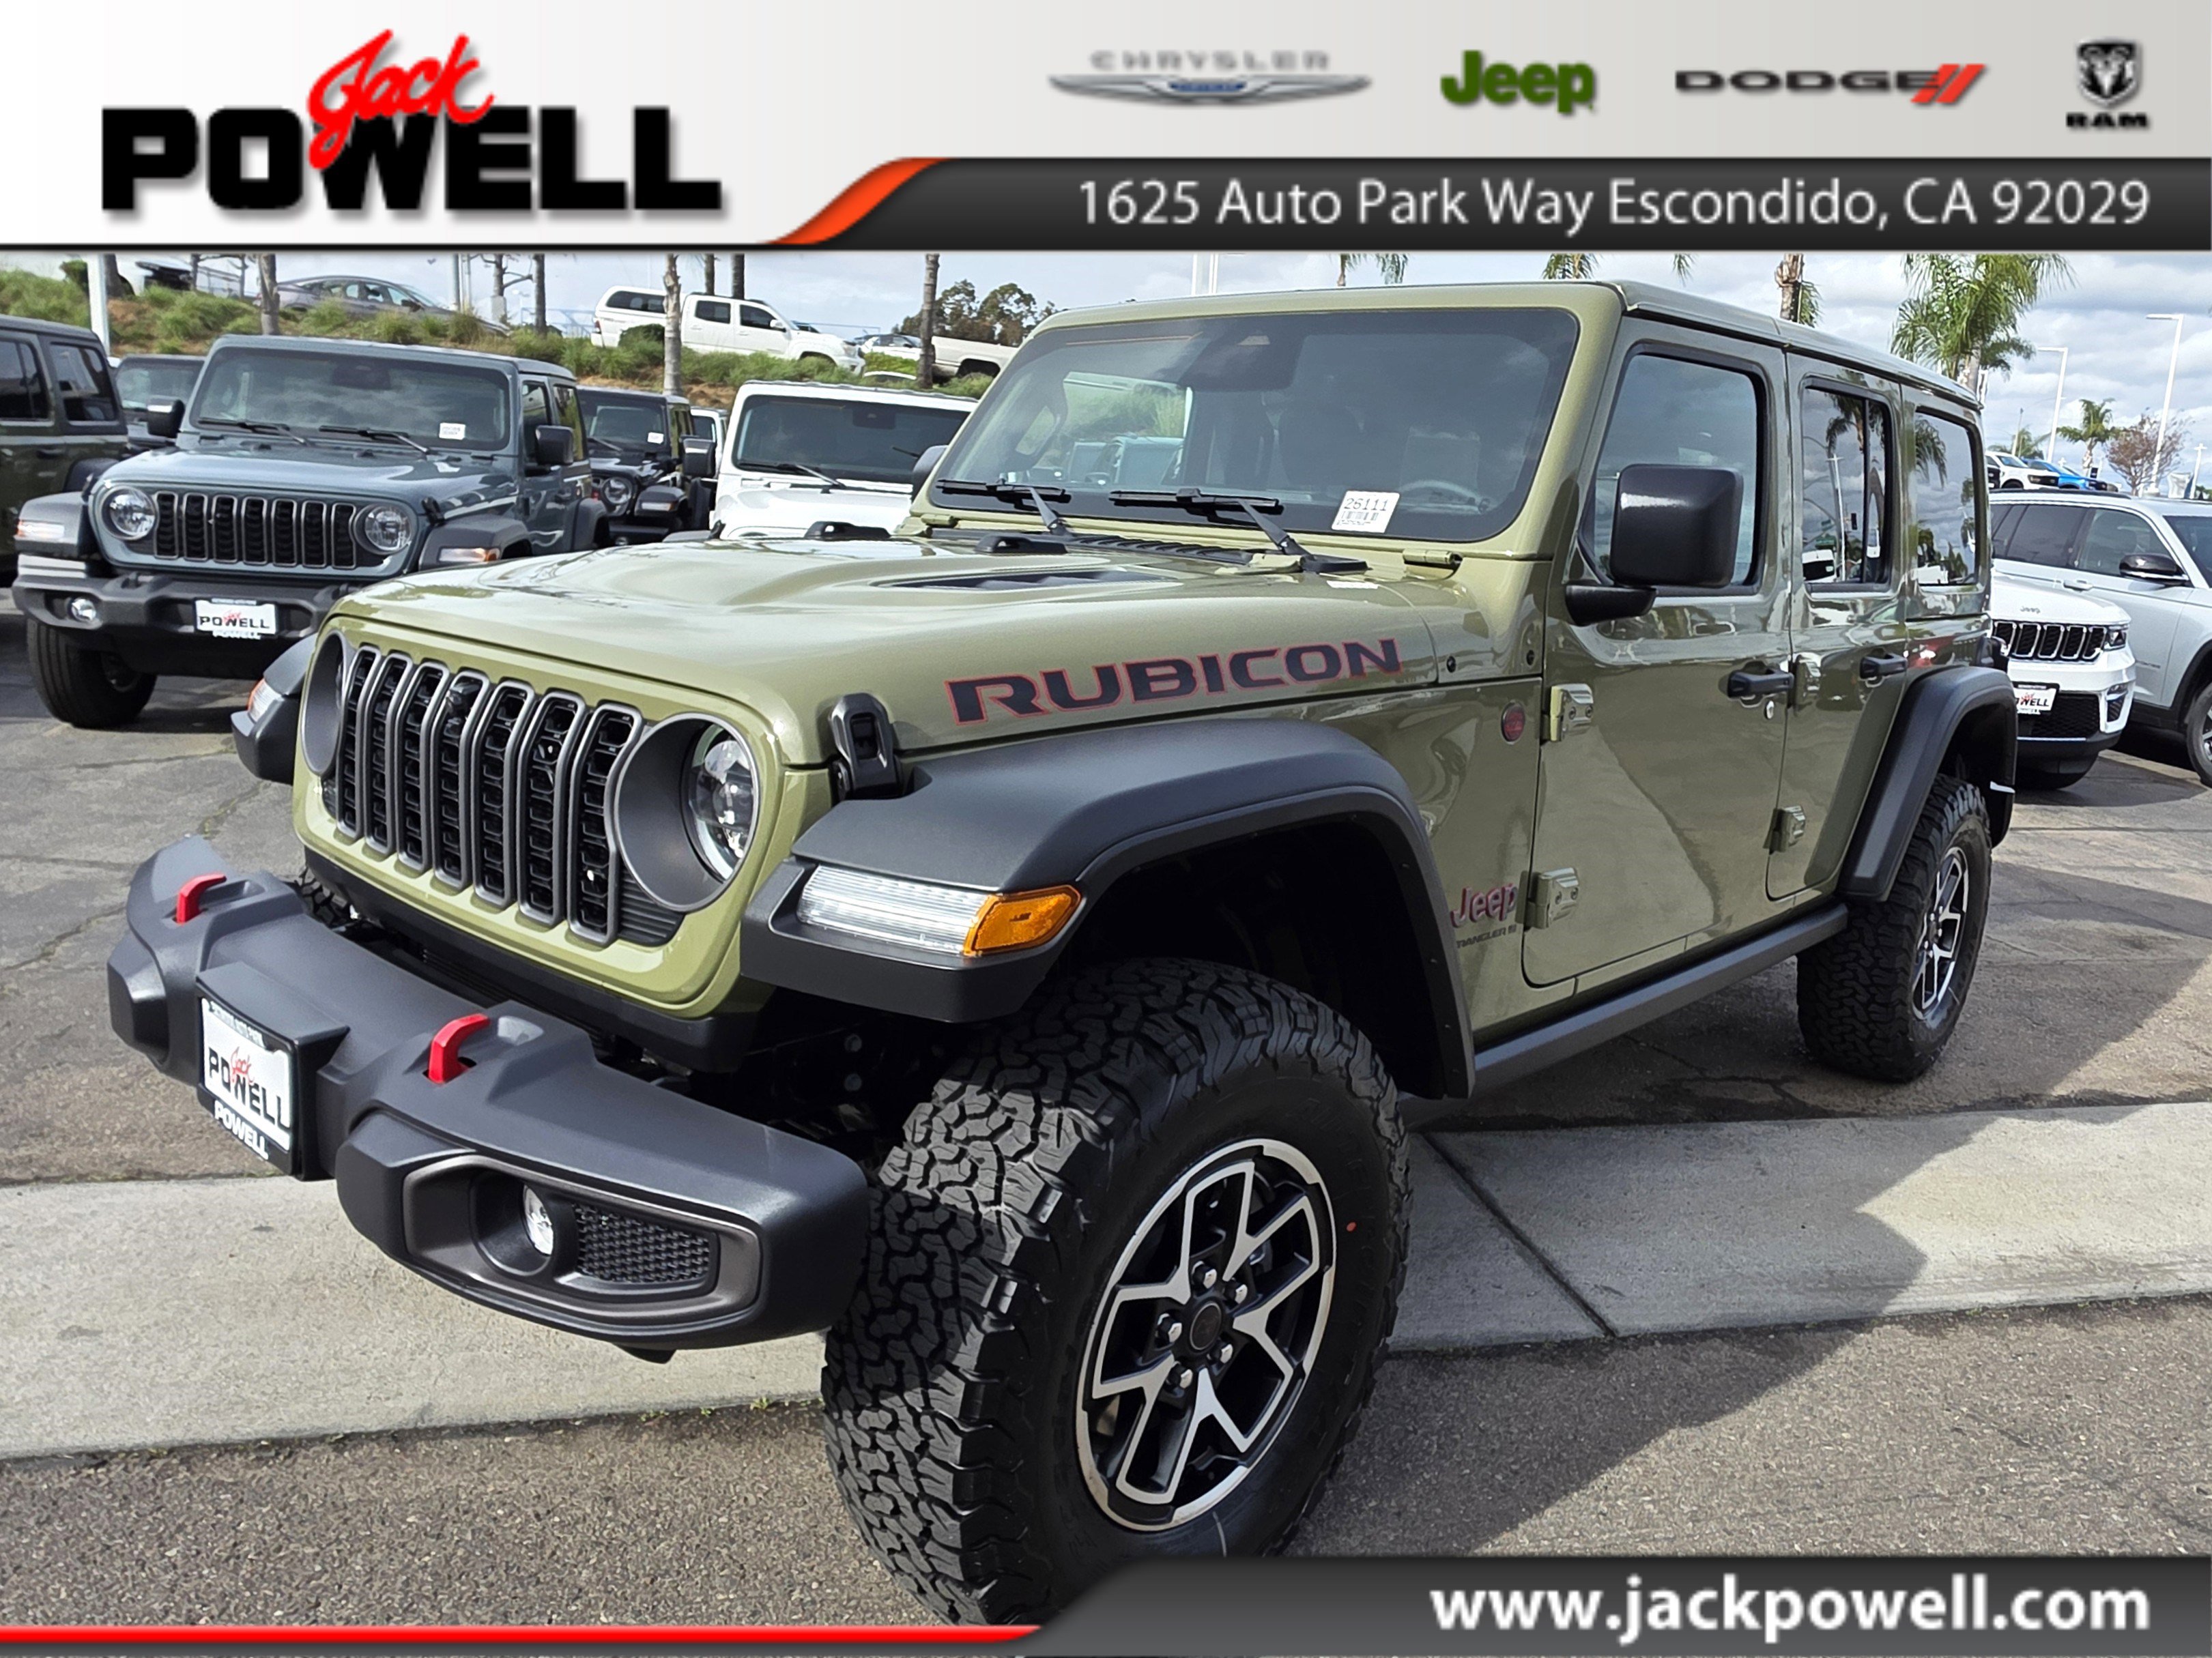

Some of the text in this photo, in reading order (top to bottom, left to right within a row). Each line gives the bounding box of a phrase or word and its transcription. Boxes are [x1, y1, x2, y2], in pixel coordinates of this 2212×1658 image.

[1344, 497, 1389, 511] 26111
[199, 615, 270, 629] POWELL
[945, 638, 1404, 725] RUBICON
[1450, 884, 1518, 928] Jeep
[1456, 927, 1506, 948] RANGLER
[208, 1045, 291, 1129] POWELL
[214, 1099, 269, 1161] POWELL
